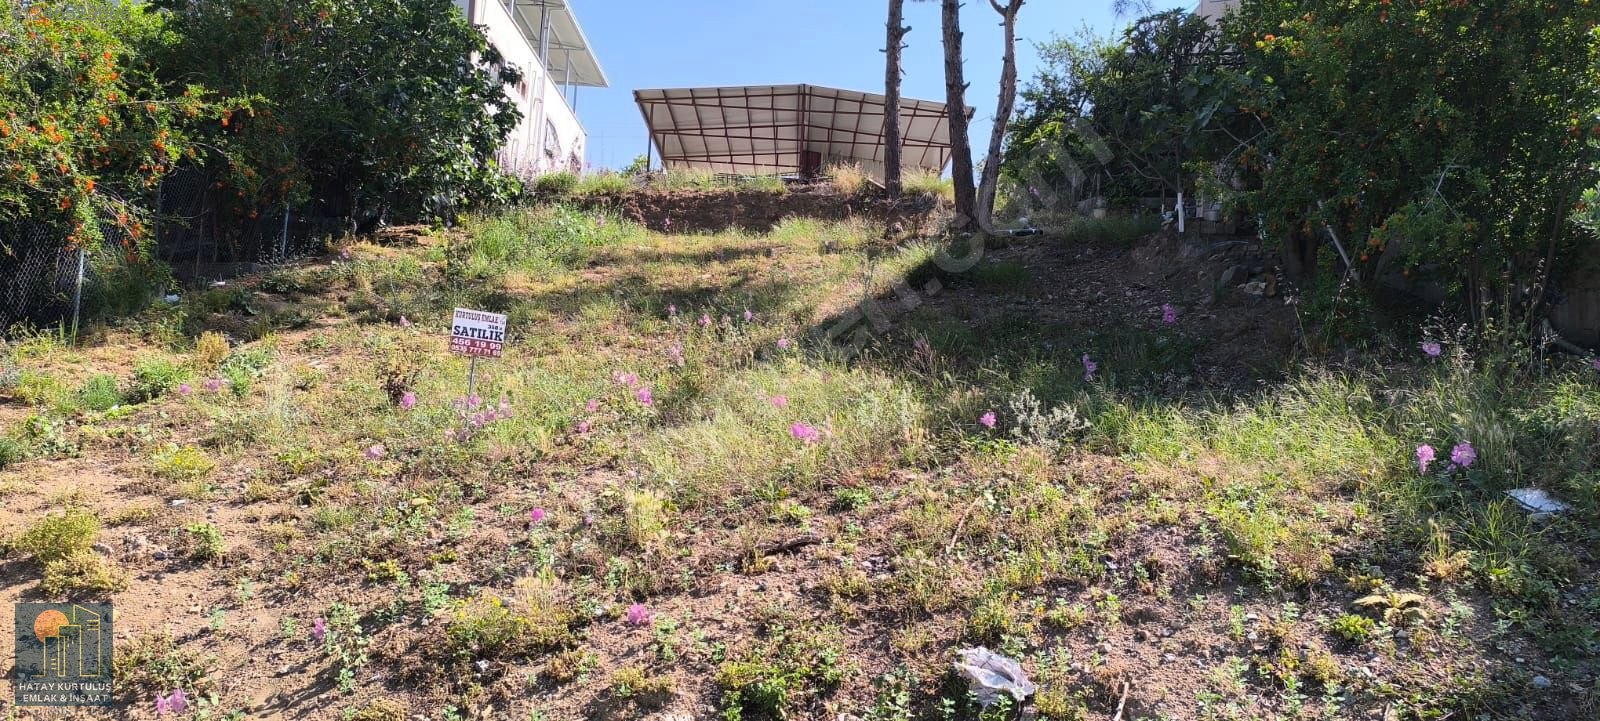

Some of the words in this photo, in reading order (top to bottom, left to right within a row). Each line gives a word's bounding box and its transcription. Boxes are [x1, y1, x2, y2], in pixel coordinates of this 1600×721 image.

[452, 337, 471, 346] 456
[475, 340, 487, 348] 19
[469, 346, 482, 354] 777
